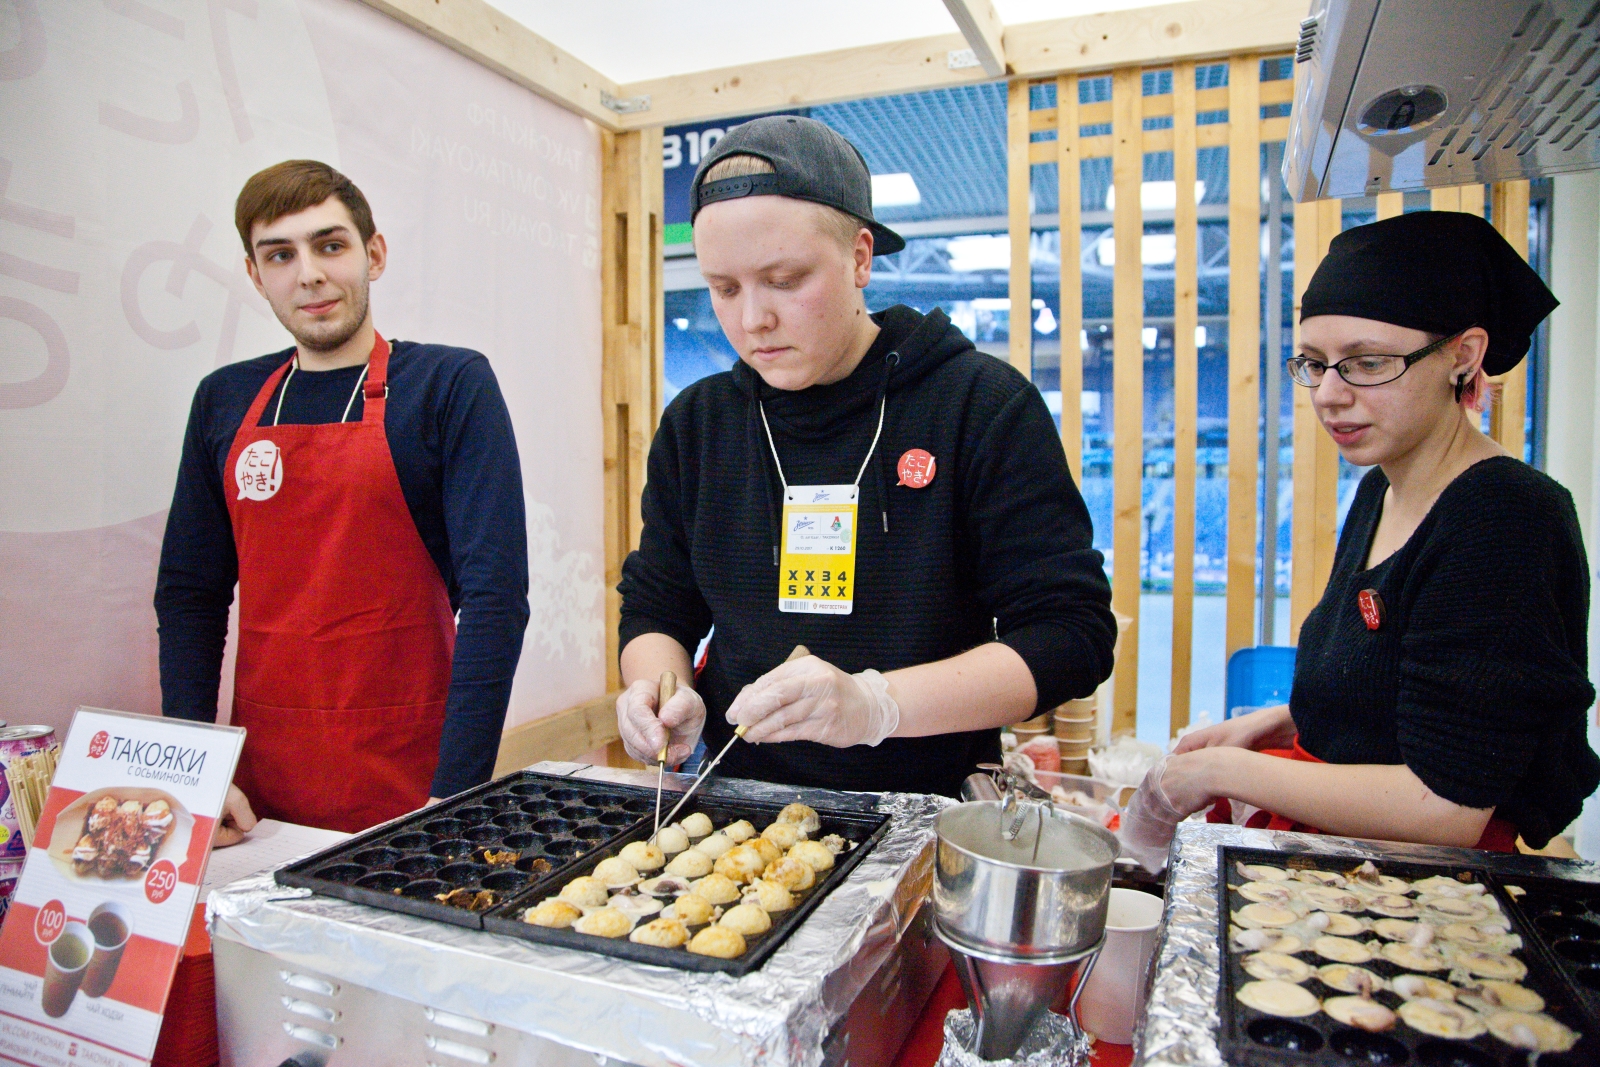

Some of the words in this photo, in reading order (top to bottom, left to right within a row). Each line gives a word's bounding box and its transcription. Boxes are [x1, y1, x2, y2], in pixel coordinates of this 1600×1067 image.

[788, 570, 798, 580] X
[805, 570, 815, 581] X
[822, 571, 831, 581] 3
[837, 571, 847, 582] 4
[804, 585, 814, 596] X
[821, 586, 830, 596] X
[837, 586, 846, 597] X
[111, 736, 207, 774] ТАКОЯКИ
[135, 767, 200, 787] ОСЬМИНОГОМ
[147, 869, 175, 890] 250
[41, 909, 63, 930] 100
